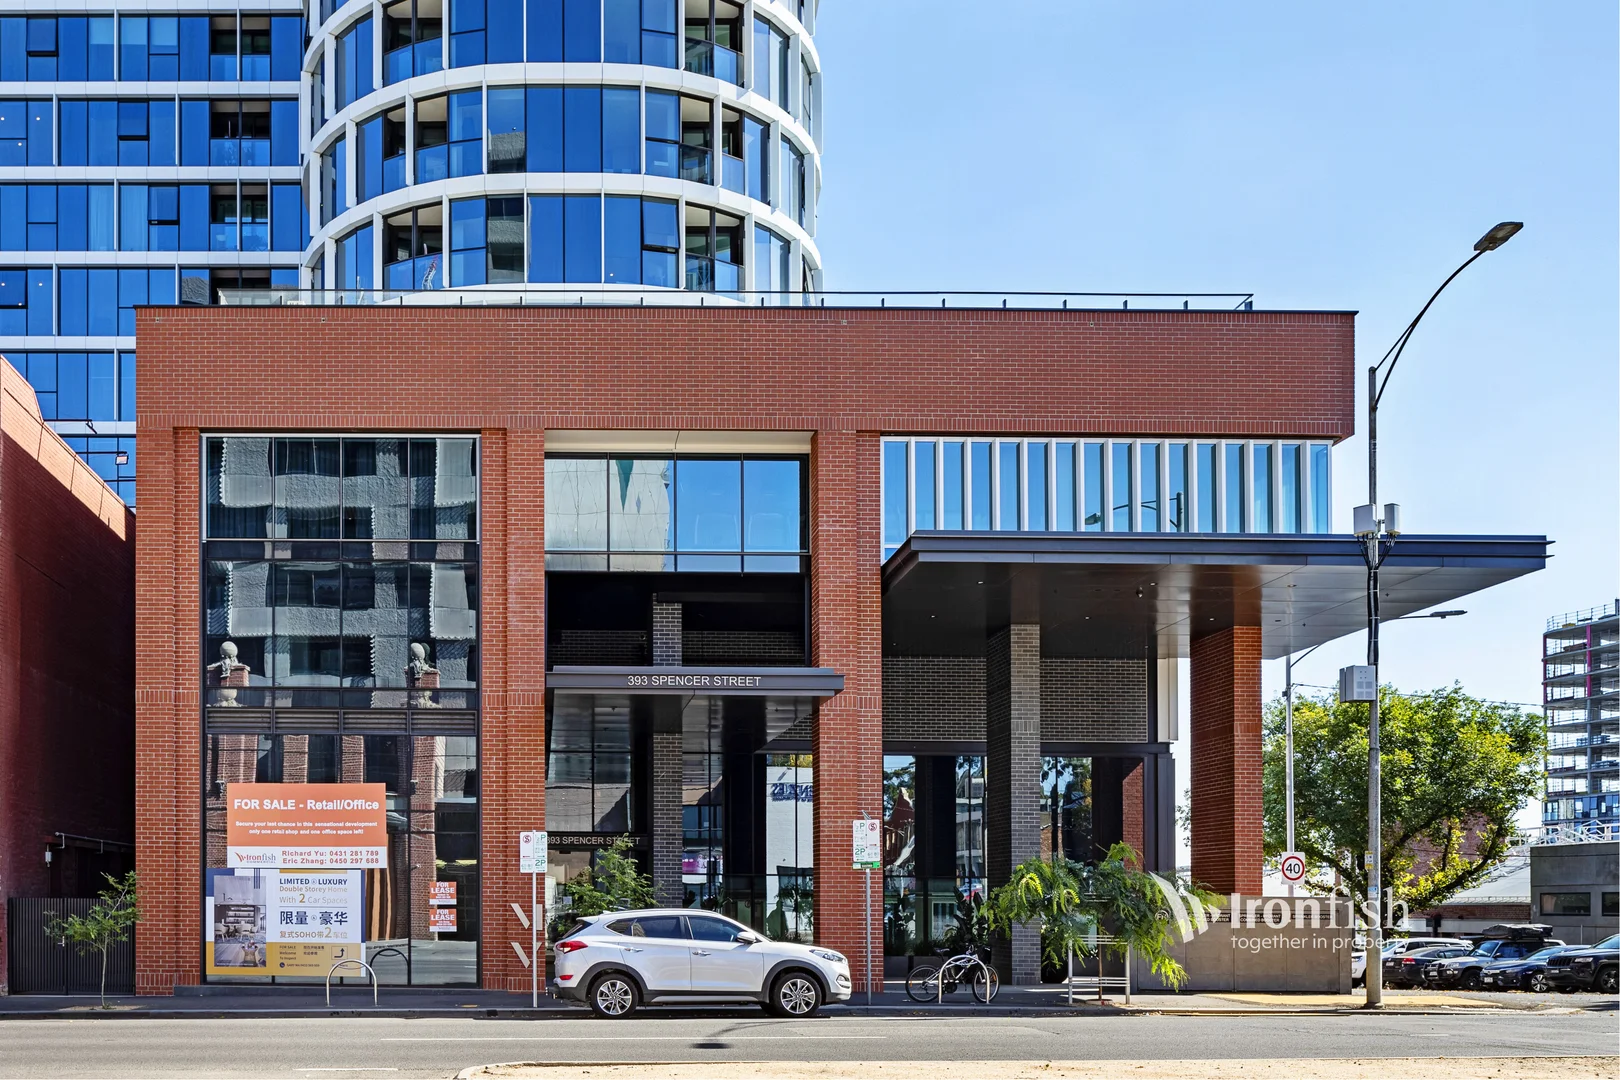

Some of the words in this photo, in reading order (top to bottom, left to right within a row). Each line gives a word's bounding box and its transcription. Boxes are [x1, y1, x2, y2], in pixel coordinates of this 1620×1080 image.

[628, 676, 648, 686] 393
[652, 676, 710, 686] SPENCER
[714, 676, 762, 686] STREET
[234, 799, 260, 810] FOR
[263, 799, 296, 810] SALE
[307, 799, 380, 810] Retail/Office
[1286, 864, 1300, 874] 40
[299, 894, 306, 903] 2
[280, 911, 308, 924] 限量
[320, 912, 348, 925] 豪华
